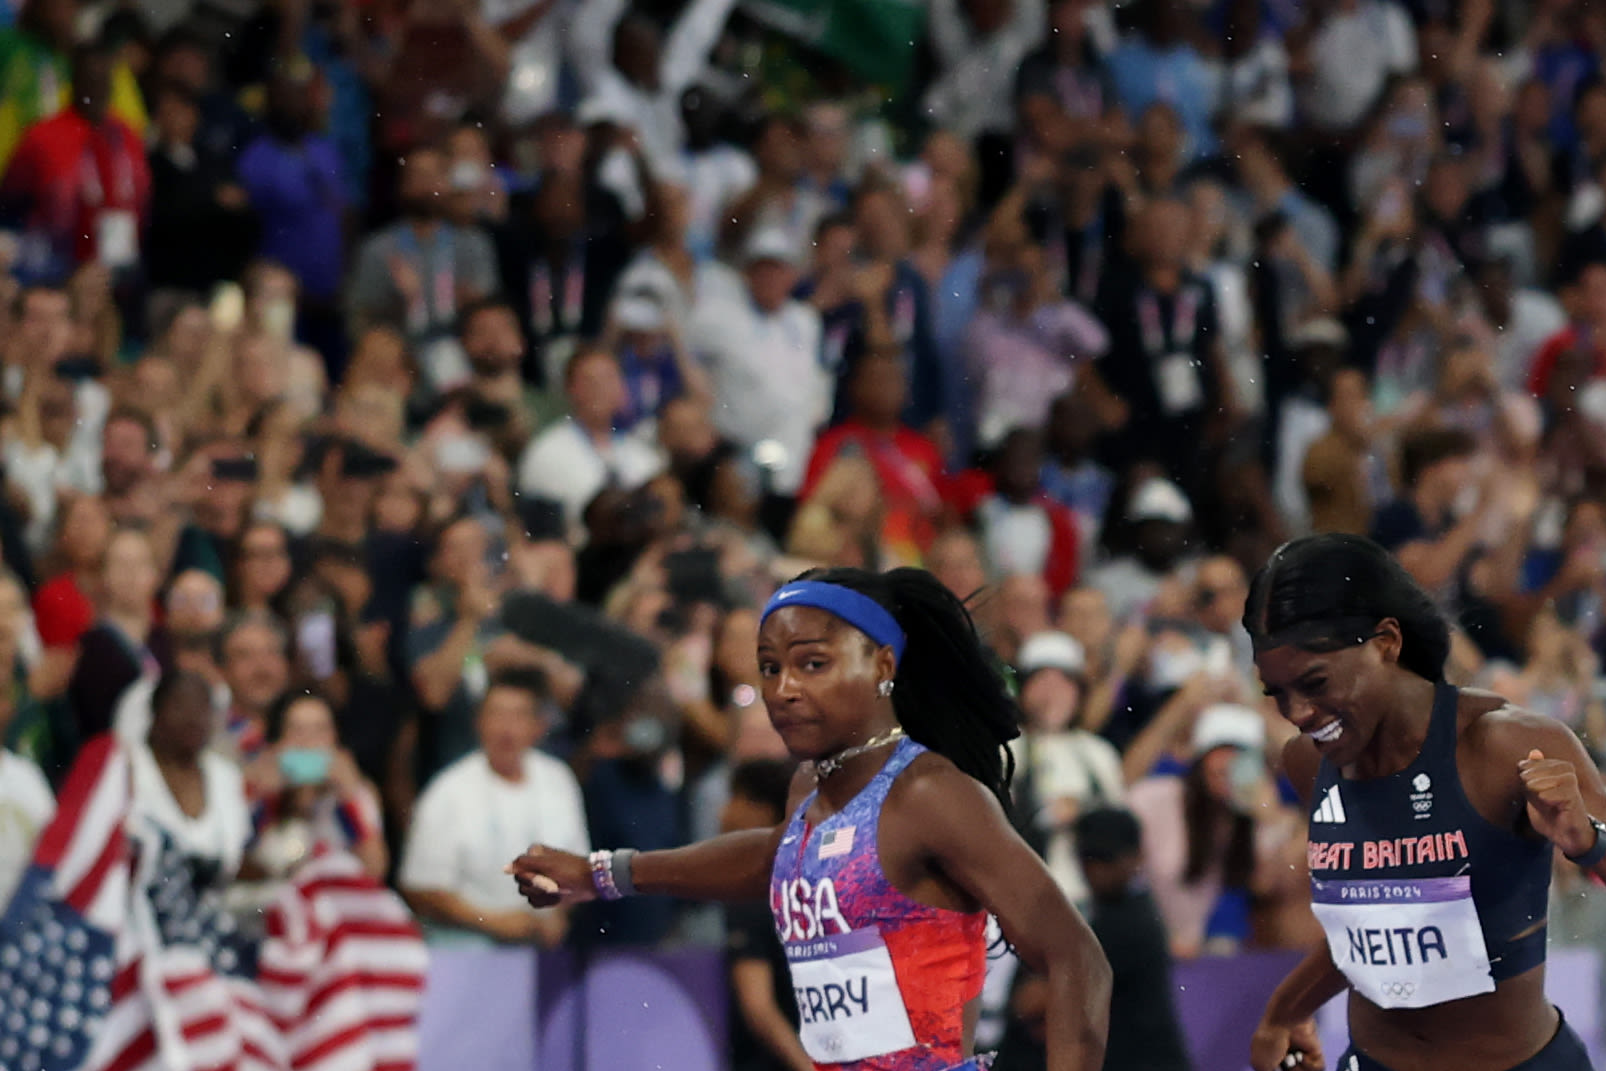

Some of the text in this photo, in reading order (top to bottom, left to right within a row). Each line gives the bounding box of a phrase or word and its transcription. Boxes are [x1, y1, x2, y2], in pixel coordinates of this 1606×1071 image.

[1363, 829, 1469, 870] BRITAIN
[769, 877, 853, 942] USA
[1340, 885, 1422, 899] PARIS 2024
[1346, 925, 1448, 965] NEITA
